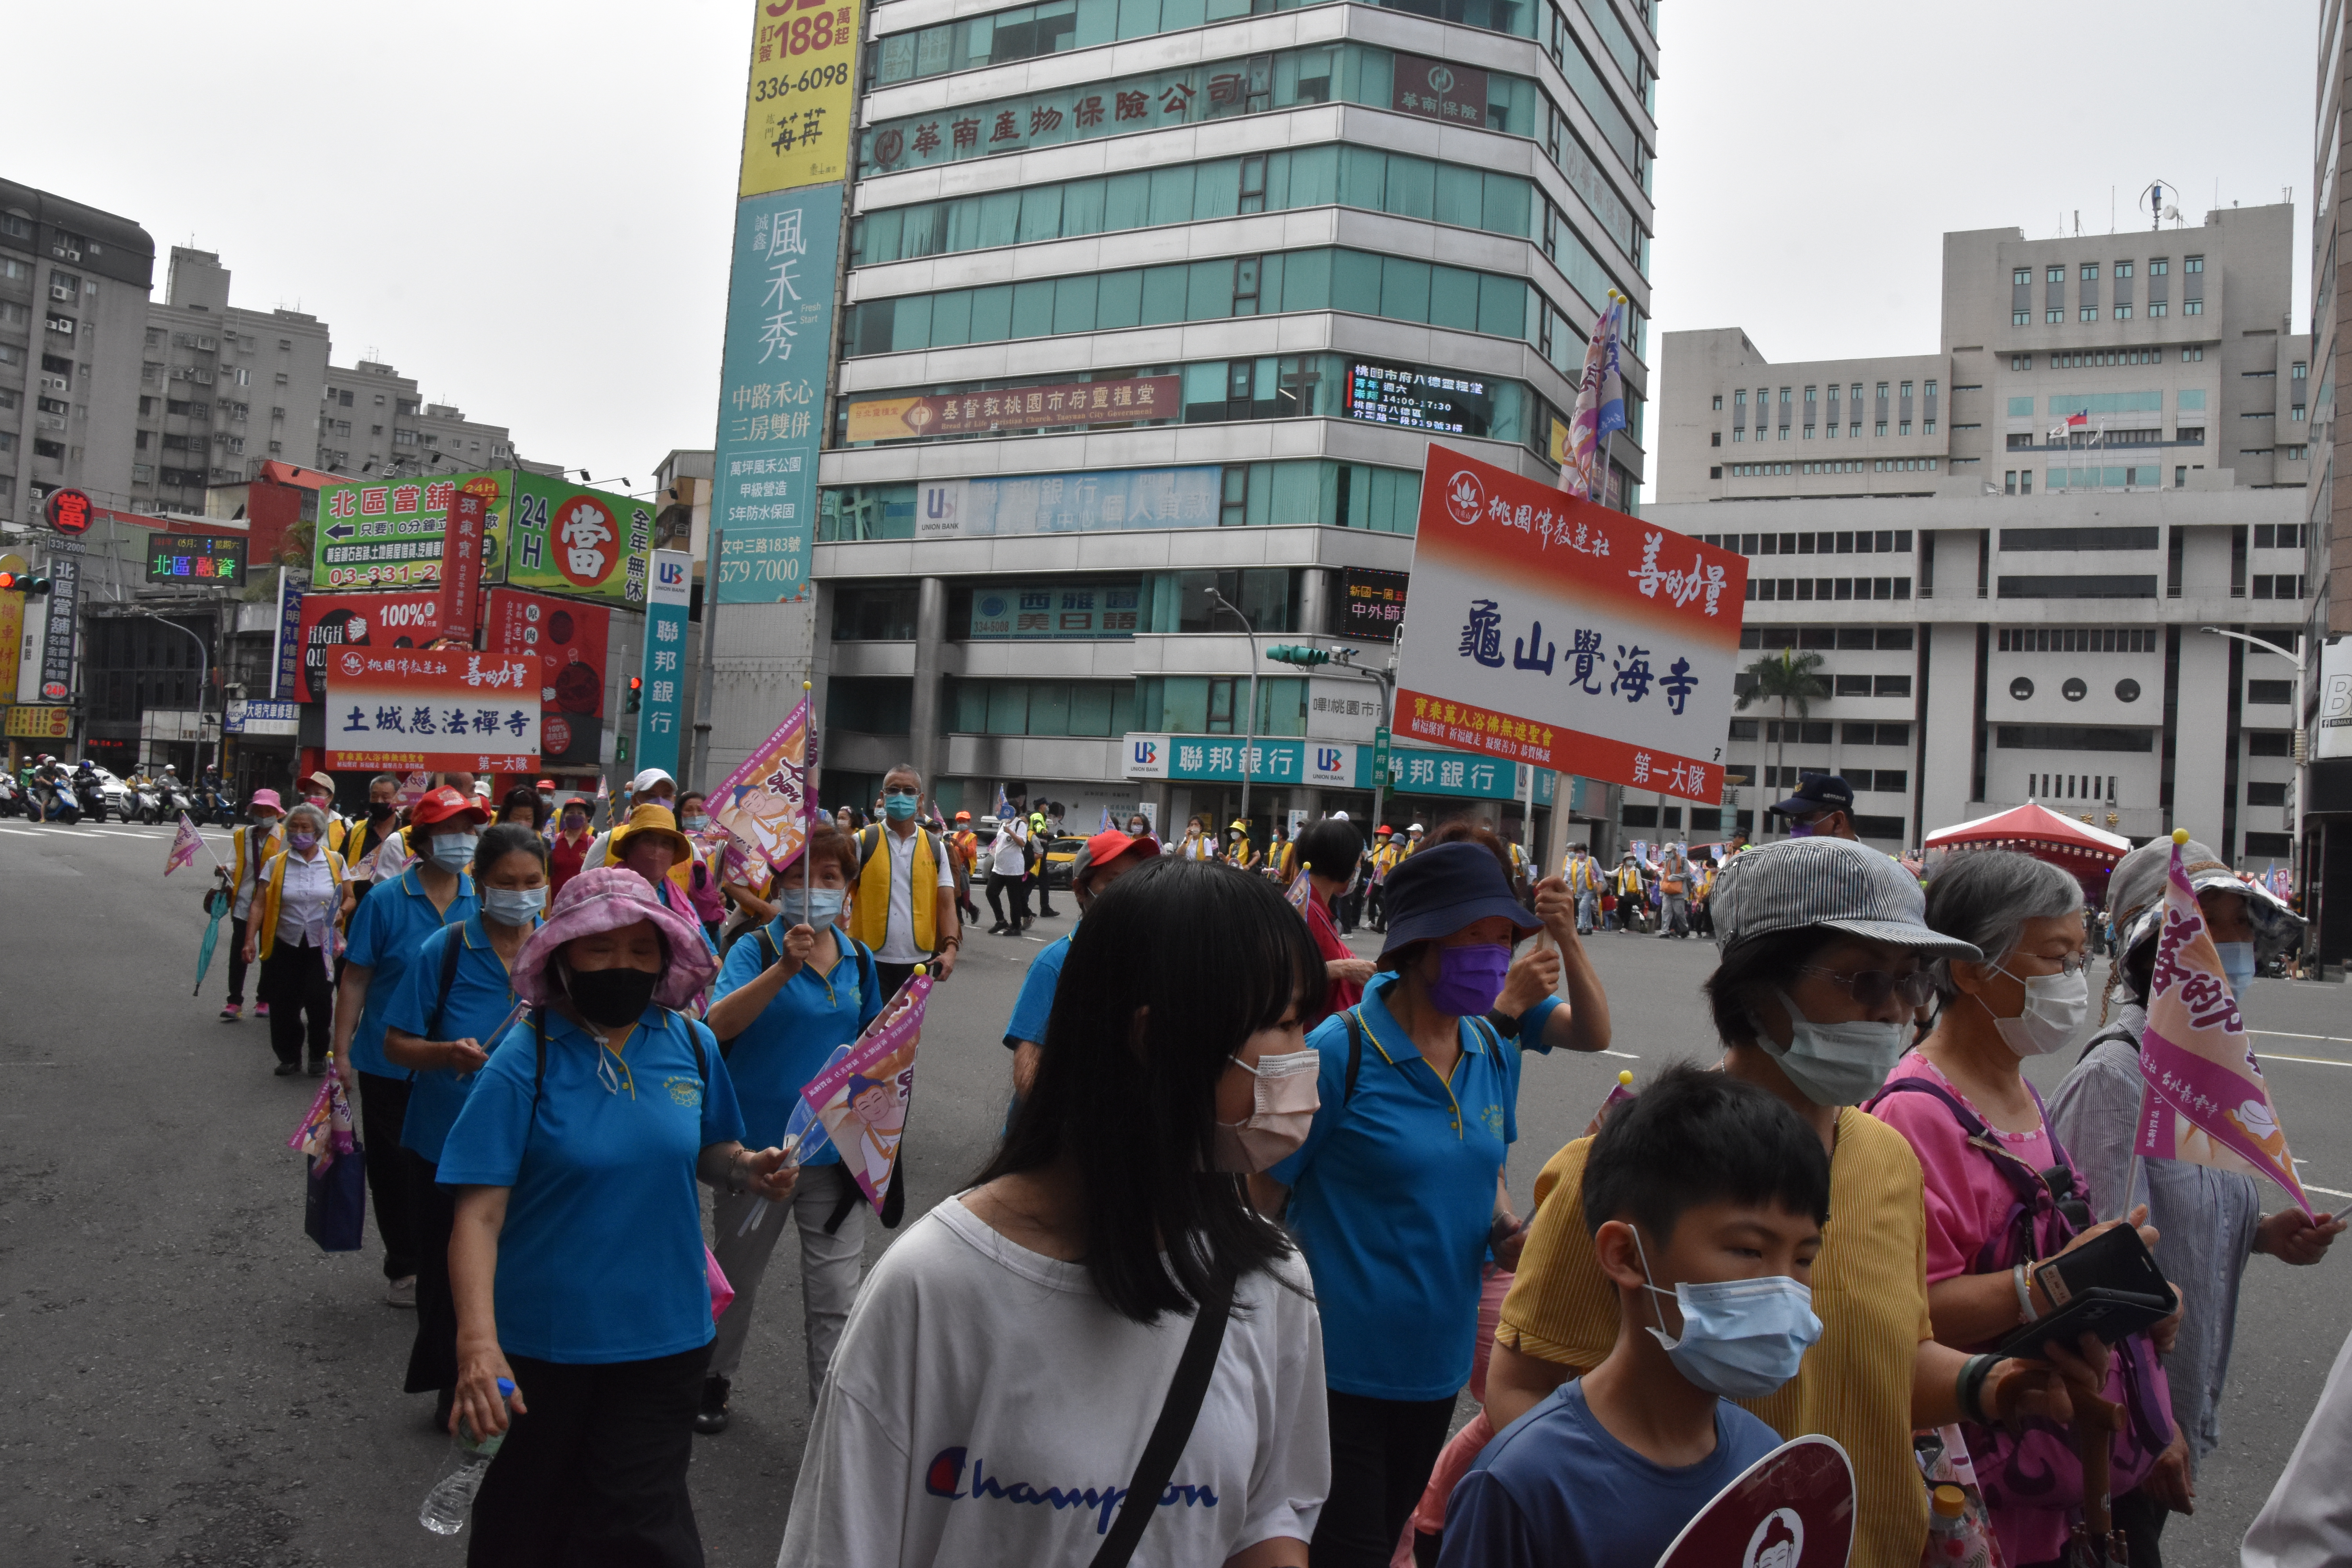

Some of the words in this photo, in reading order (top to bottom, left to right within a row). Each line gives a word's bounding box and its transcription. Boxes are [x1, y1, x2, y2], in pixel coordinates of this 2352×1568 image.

[773, 11, 834, 58] 188
[834, 7, 851, 46] 萬起
[755, 63, 848, 102] 336-6098
[911, 73, 1241, 158] 華南產物保險公司
[1401, 91, 1478, 120] 華南保險
[753, 214, 769, 251] 誠鑫
[759, 209, 807, 364] 風禾秀
[800, 315, 818, 324] Start
[801, 302, 821, 313] Fresh
[732, 379, 813, 411] 中路禾心
[942, 384, 1155, 421] 基督教桃園市府靈糧堂
[1384, 395, 1451, 411] 14:00-17:30
[729, 411, 811, 442] 三房雙併
[991, 417, 1022, 426] Christian
[1057, 413, 1085, 421] Taoyuan
[1089, 411, 1103, 419] City
[1107, 408, 1152, 417] Government
[730, 457, 802, 476] 萬坪風禾公園
[330, 481, 455, 518] 北區當舖
[465, 483, 495, 493] 24H
[740, 481, 787, 498] 甲級營造
[58, 494, 88, 529] 當
[521, 494, 548, 532] 24
[729, 503, 795, 521] 5年防水保固
[1488, 495, 1610, 558] 桃園佛教蓮社
[50, 539, 86, 554] 331-2000
[521, 534, 542, 570] H
[561, 504, 612, 579] 當
[625, 508, 651, 602] 全年無休
[722, 536, 801, 555] 文中三路183號
[152, 555, 235, 579] 北區融資
[719, 561, 750, 583] 379
[755, 559, 799, 581] 7000
[1629, 532, 1727, 617] 善的力量
[51, 562, 75, 635] 北區當舖
[1020, 592, 1137, 610] 西雅圖
[1352, 602, 1406, 622] 中外師
[380, 603, 424, 627] 100%
[974, 621, 1009, 632] 334-5008
[1017, 612, 1137, 631] 美日語
[309, 626, 343, 644] HIGH
[307, 648, 327, 667] QU
[461, 656, 527, 688] 善的力量
[1458, 599, 1699, 716] 龜山覺海寺
[45, 684, 66, 697] 24H
[651, 620, 679, 733] 聯邦銀行
[2322, 674, 2352, 718] B
[343, 706, 530, 738] 土城慈法禪寺
[1415, 697, 1554, 747] 寶乘萬人浴佛無遮聖會
[1412, 717, 1445, 737] 植福聚寶
[1450, 727, 1481, 746] 祈福健走
[1486, 736, 1517, 755] 凝聚善力
[1521, 744, 1551, 762] 恭賀佛誕
[479, 756, 528, 771] 第一大隊
[1179, 746, 1294, 775] 聯邦銀行
[1633, 752, 1706, 796] 第一大隊
[926, 1445, 1219, 1535] Champon
